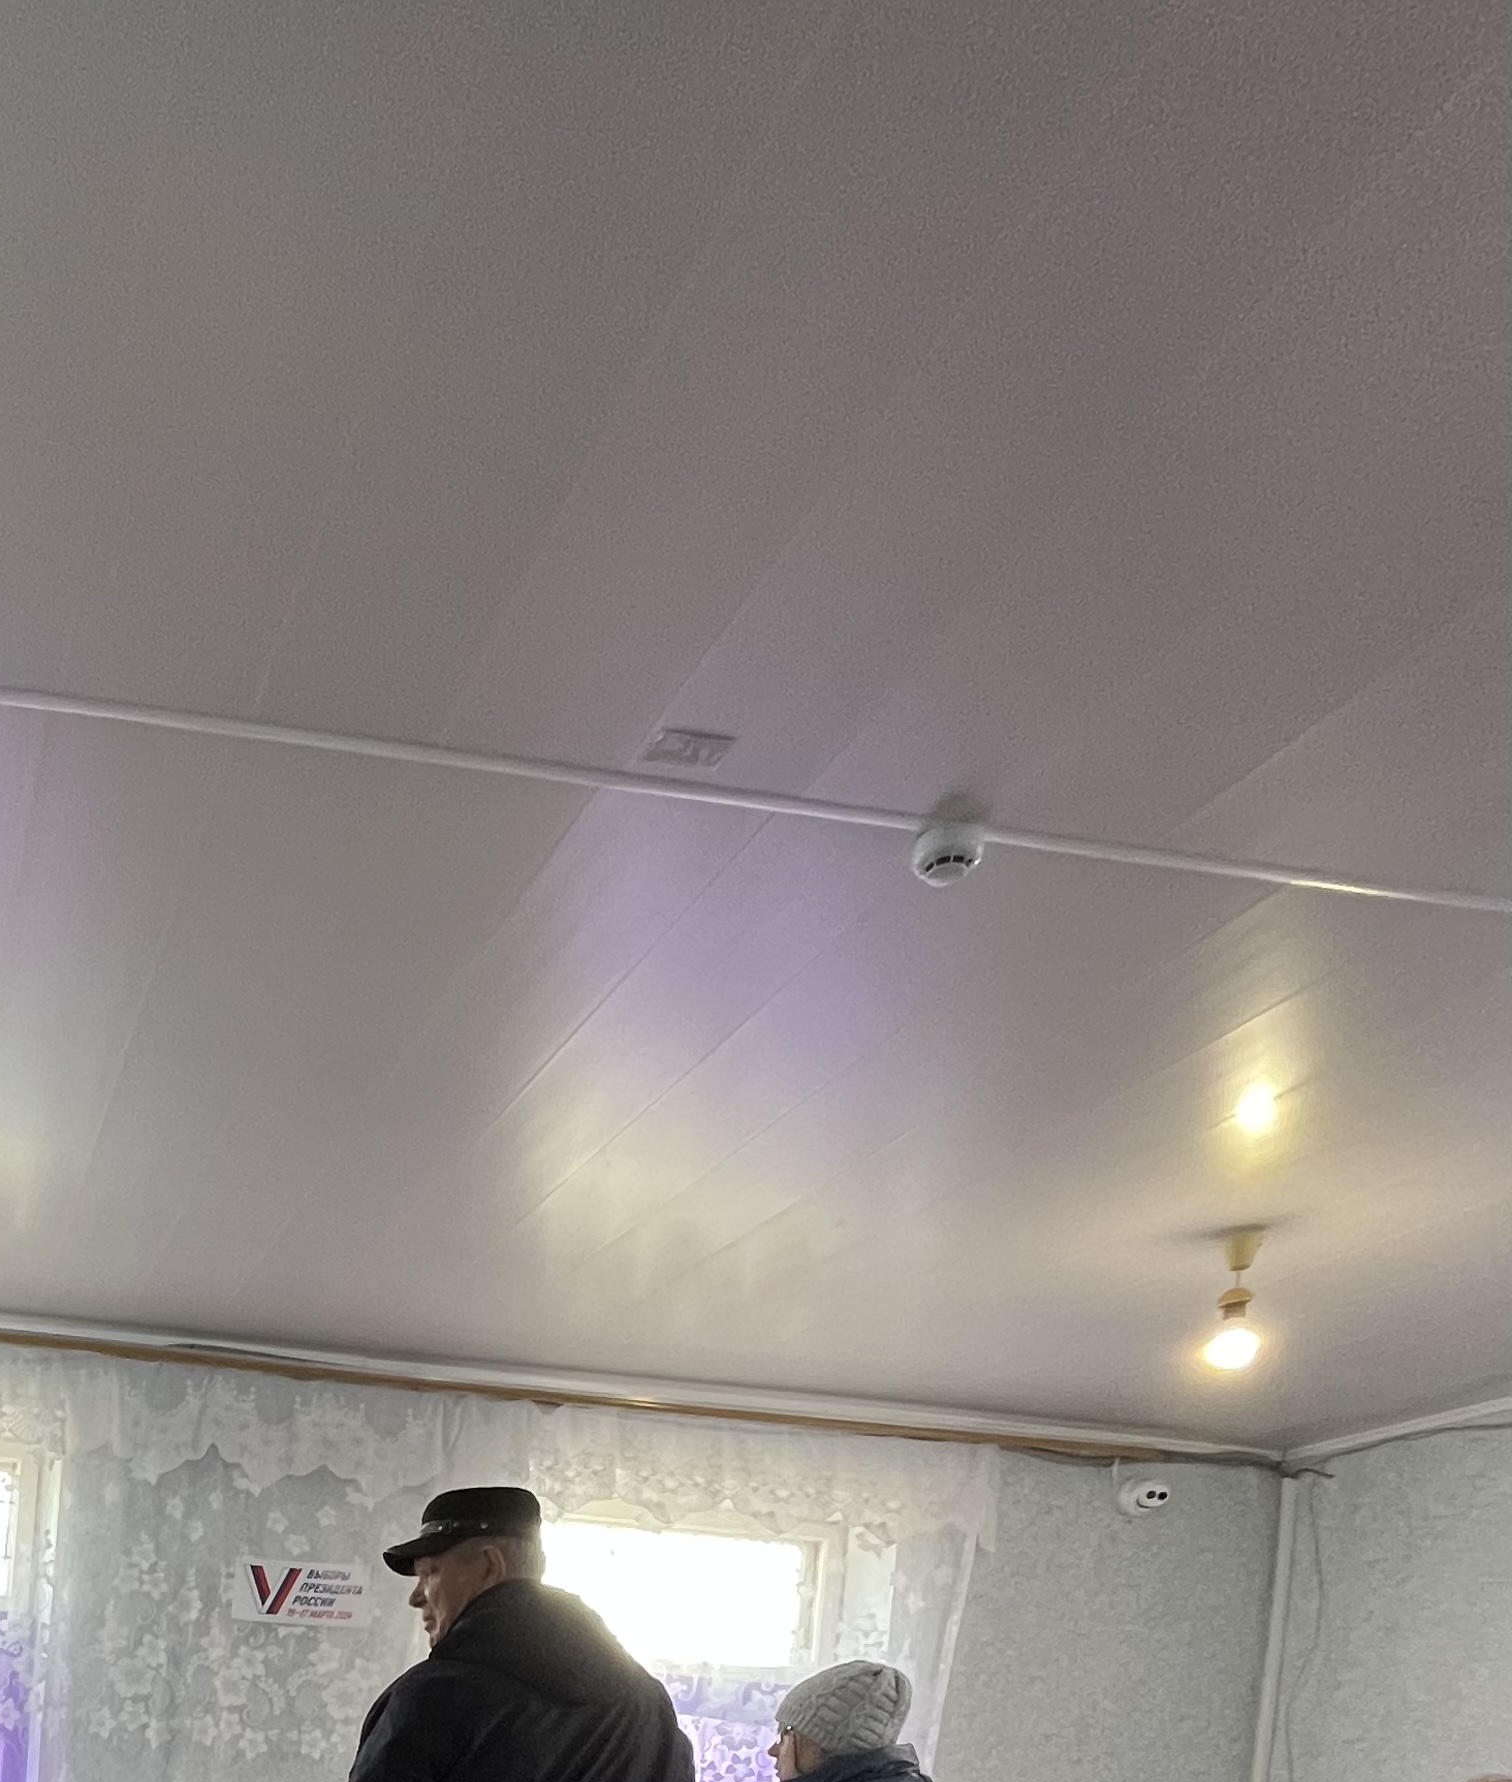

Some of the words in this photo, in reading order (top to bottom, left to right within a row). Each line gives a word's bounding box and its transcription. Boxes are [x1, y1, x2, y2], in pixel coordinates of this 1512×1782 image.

[306, 1568, 352, 1581] ВЫБОРЫ
[299, 1582, 363, 1596] ПРЕЗИДЕНТА
[291, 1595, 336, 1608] РОССИИ
